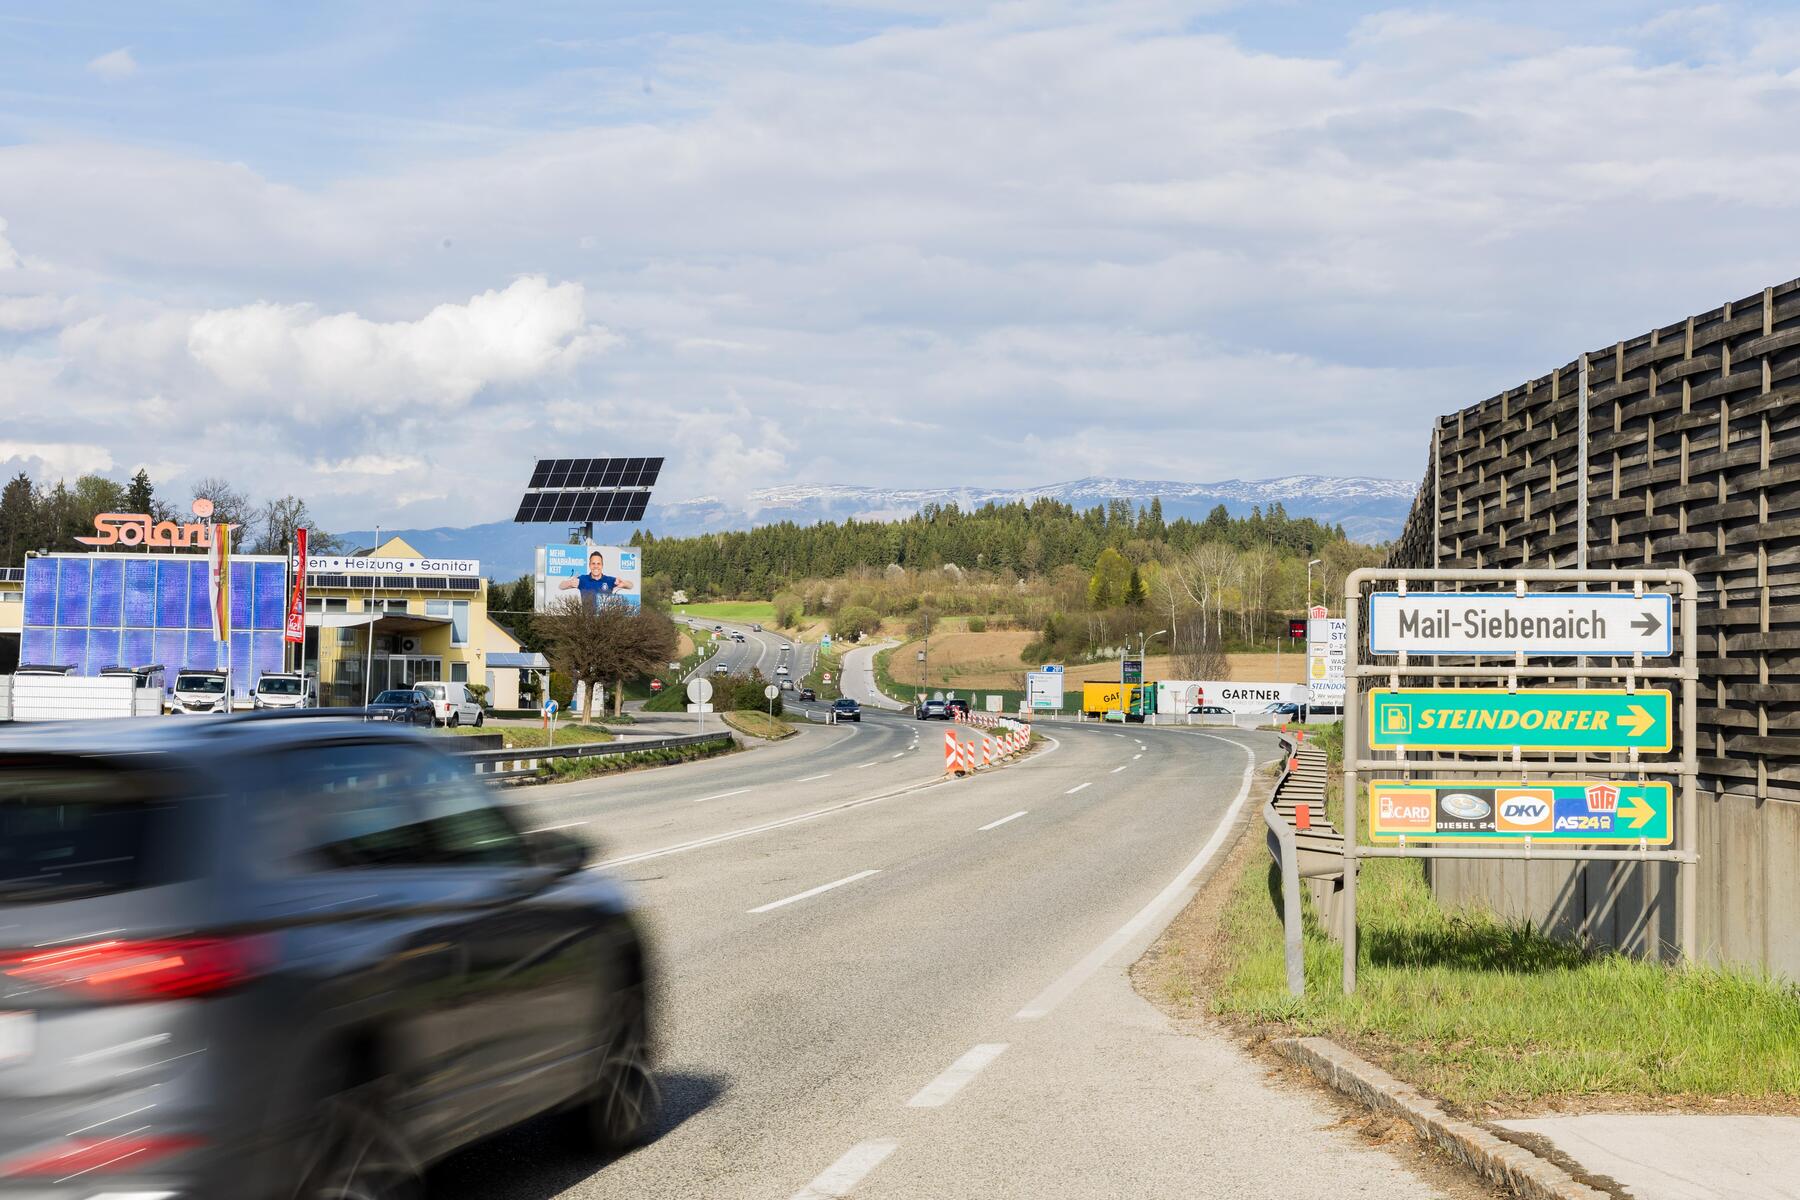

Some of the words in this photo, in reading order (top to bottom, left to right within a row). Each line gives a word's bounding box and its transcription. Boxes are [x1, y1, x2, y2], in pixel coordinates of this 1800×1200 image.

[345, 559, 403, 572] Heizung
[421, 559, 473, 572] Sanitär
[1329, 621, 1346, 630] TAN
[1399, 609, 1606, 639] Mail-Siebenaich
[1222, 689, 1280, 700] GARTNER
[1418, 709, 1610, 730] STEINDORFER
[1588, 785, 1617, 810] UTA
[1393, 806, 1430, 819] CARD
[1504, 804, 1546, 817] DKV
[1555, 816, 1600, 829] AS24
